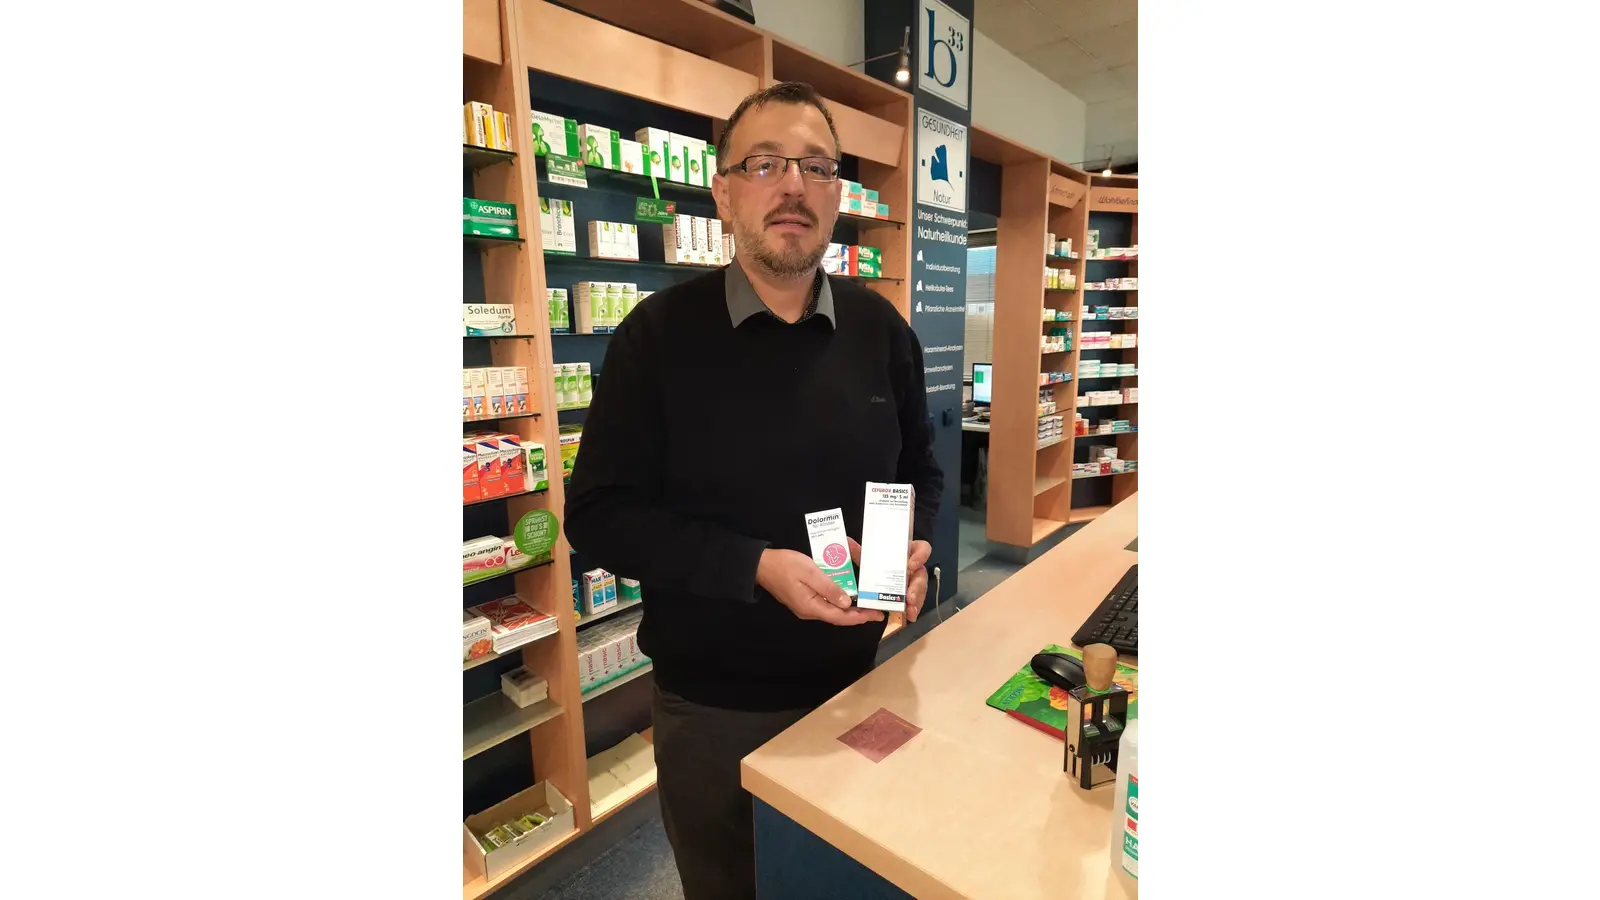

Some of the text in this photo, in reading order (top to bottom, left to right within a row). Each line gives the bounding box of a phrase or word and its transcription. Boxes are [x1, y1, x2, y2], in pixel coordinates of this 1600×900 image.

[922, 115, 963, 142] GESUNDHEIT
[933, 189, 951, 204] Natur
[478, 205, 512, 216] ASPIRIN
[917, 208, 968, 229] Unser Schwerpunkt:
[917, 225, 968, 246] Naturheilkunde
[468, 306, 511, 315] Soledum
[808, 514, 839, 525] Dolormin
[477, 545, 502, 556] angin
[878, 593, 896, 601] Basics
